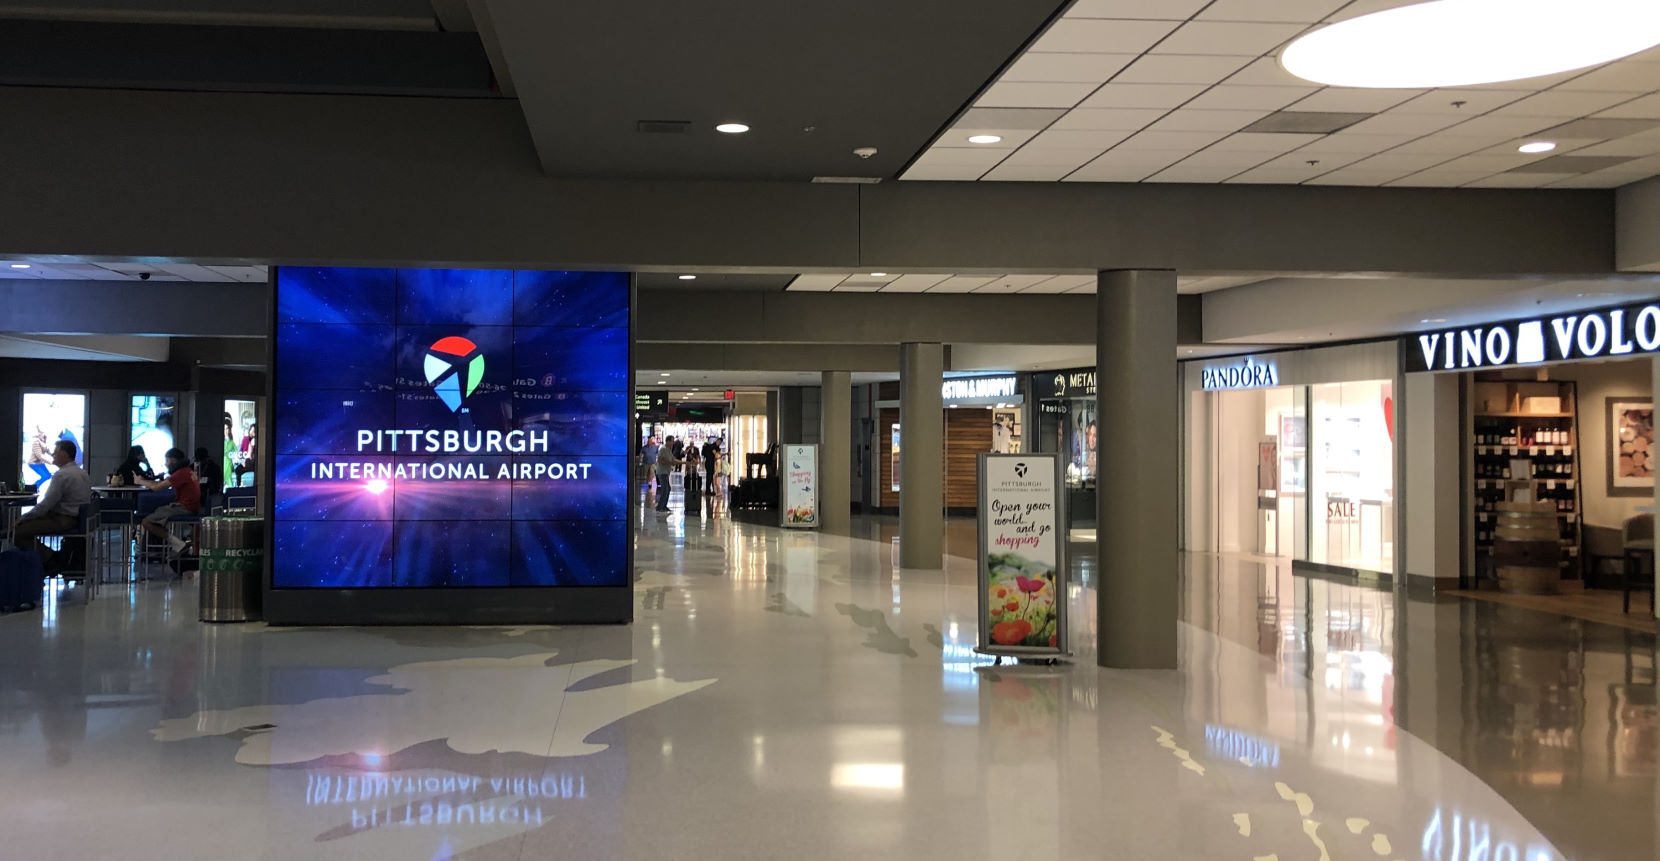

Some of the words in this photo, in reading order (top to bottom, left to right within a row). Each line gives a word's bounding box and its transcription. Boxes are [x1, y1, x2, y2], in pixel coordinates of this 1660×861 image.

[1419, 326, 1510, 370] VINO
[1551, 306, 1660, 359] VOLO
[1201, 363, 1274, 389] PANDORA
[969, 379, 975, 398] &
[976, 377, 1016, 397] MURPHY
[357, 430, 548, 452] PITTSBURGH
[311, 462, 489, 479] INTERNATIONAL
[497, 463, 592, 479] AIRPORT
[991, 499, 1021, 516] Open
[1026, 502, 1051, 515] your
[1327, 501, 1356, 518] SALE
[1016, 521, 1035, 533] and
[1039, 524, 1051, 536] go
[995, 533, 1039, 549] shopping
